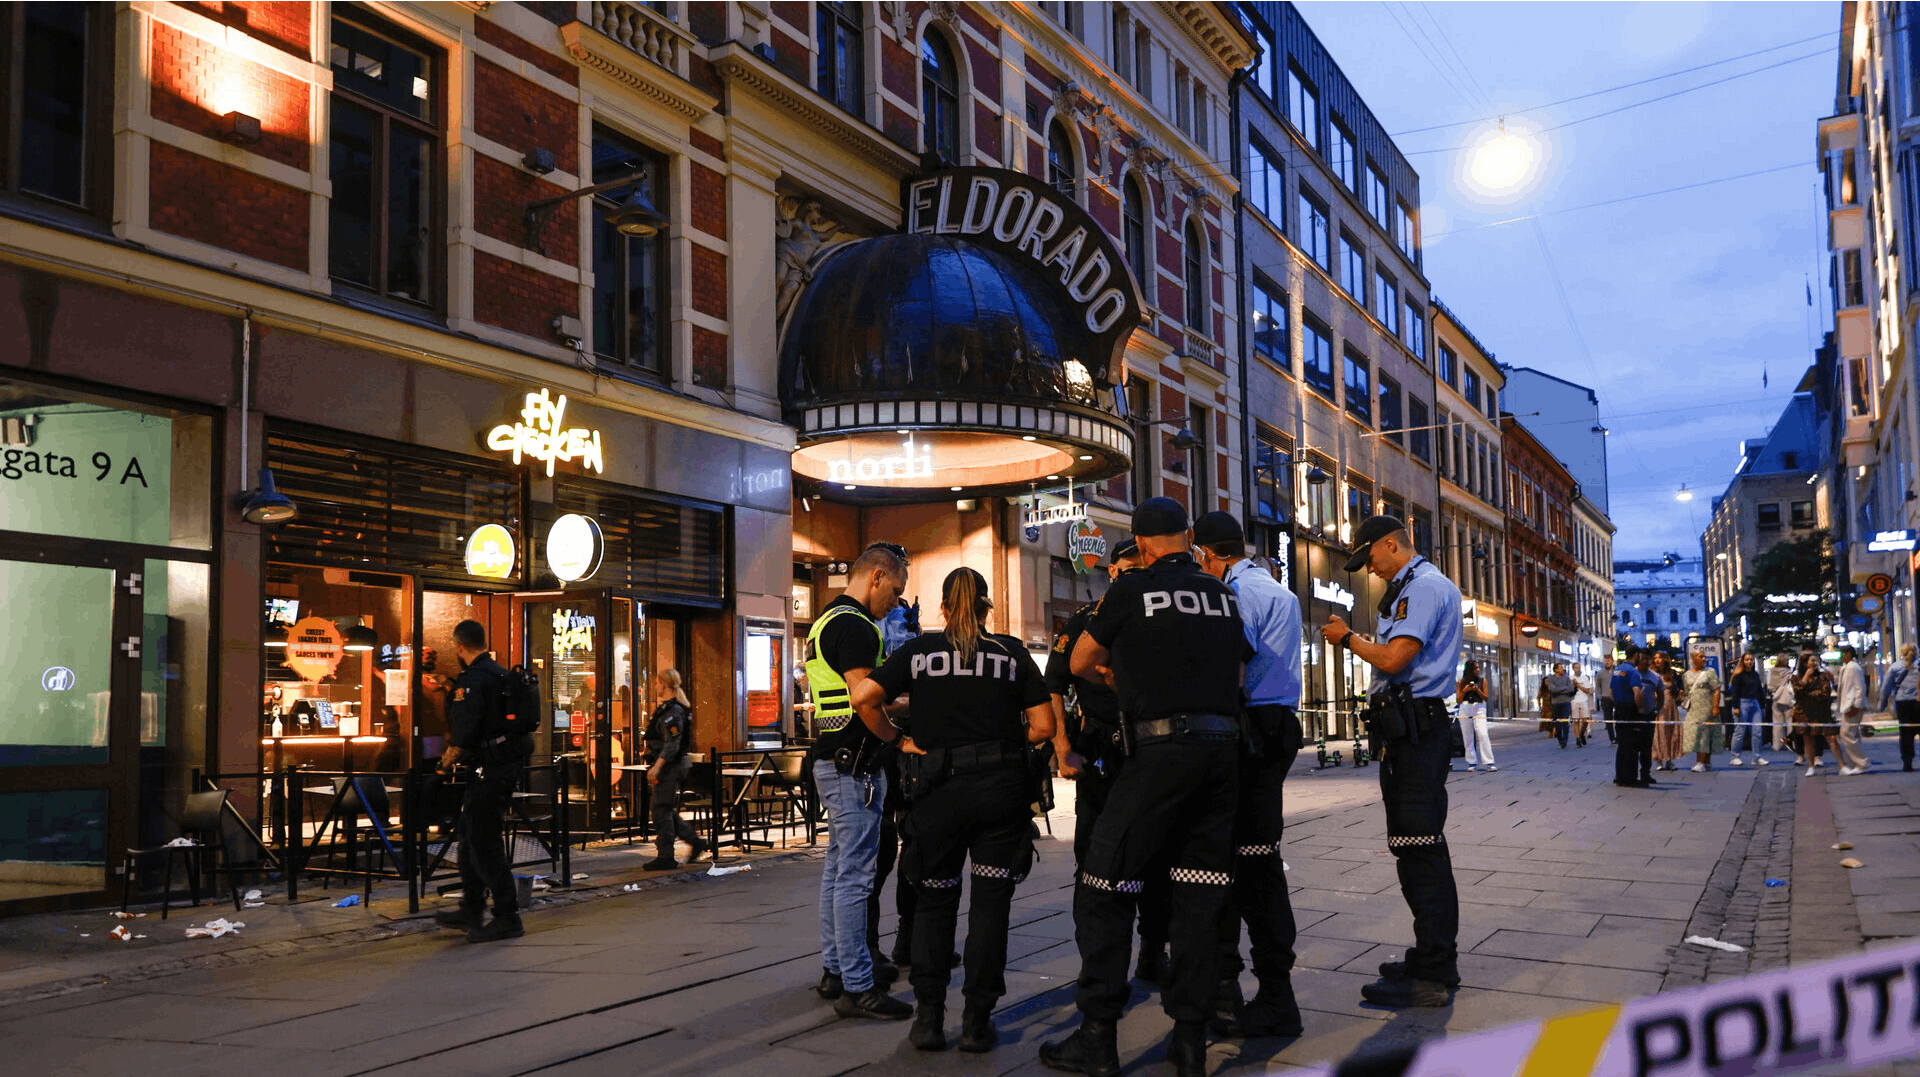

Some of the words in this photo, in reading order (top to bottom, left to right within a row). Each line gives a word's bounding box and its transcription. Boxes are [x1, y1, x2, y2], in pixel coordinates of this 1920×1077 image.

[908, 175, 1127, 334] ELDORADO
[0, 448, 77, 480] gata
[92, 451, 111, 481] 9
[120, 456, 148, 488] A
[827, 441, 934, 482] norli
[1069, 523, 1107, 561] Greenie
[1143, 590, 1239, 617] POLI
[911, 650, 1017, 681] POLITI
